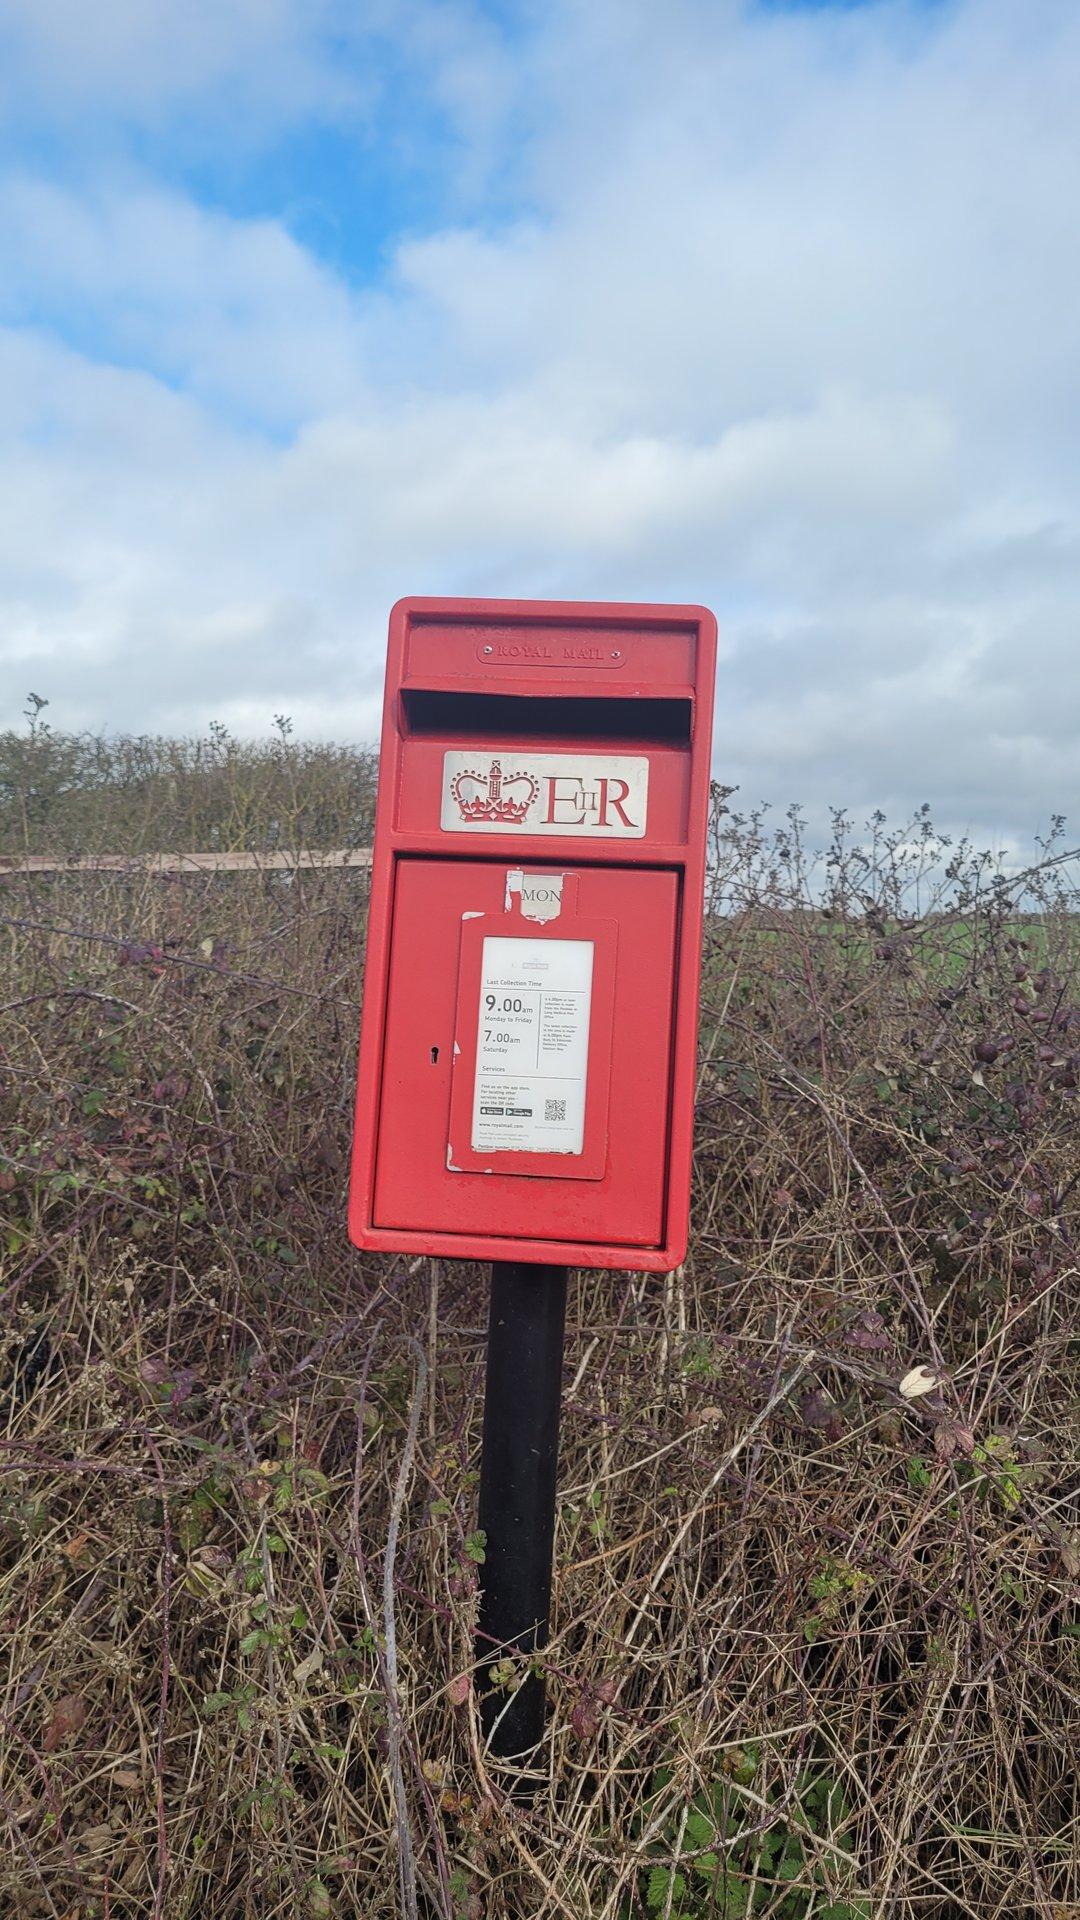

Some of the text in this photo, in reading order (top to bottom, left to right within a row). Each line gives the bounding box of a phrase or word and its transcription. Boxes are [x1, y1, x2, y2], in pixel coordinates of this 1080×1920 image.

[497, 645, 604, 659] ROYAL MAIL
[521, 889, 562, 902] MON
[485, 995, 534, 1013] 9.00am
[484, 1030, 520, 1043] 7.00am
